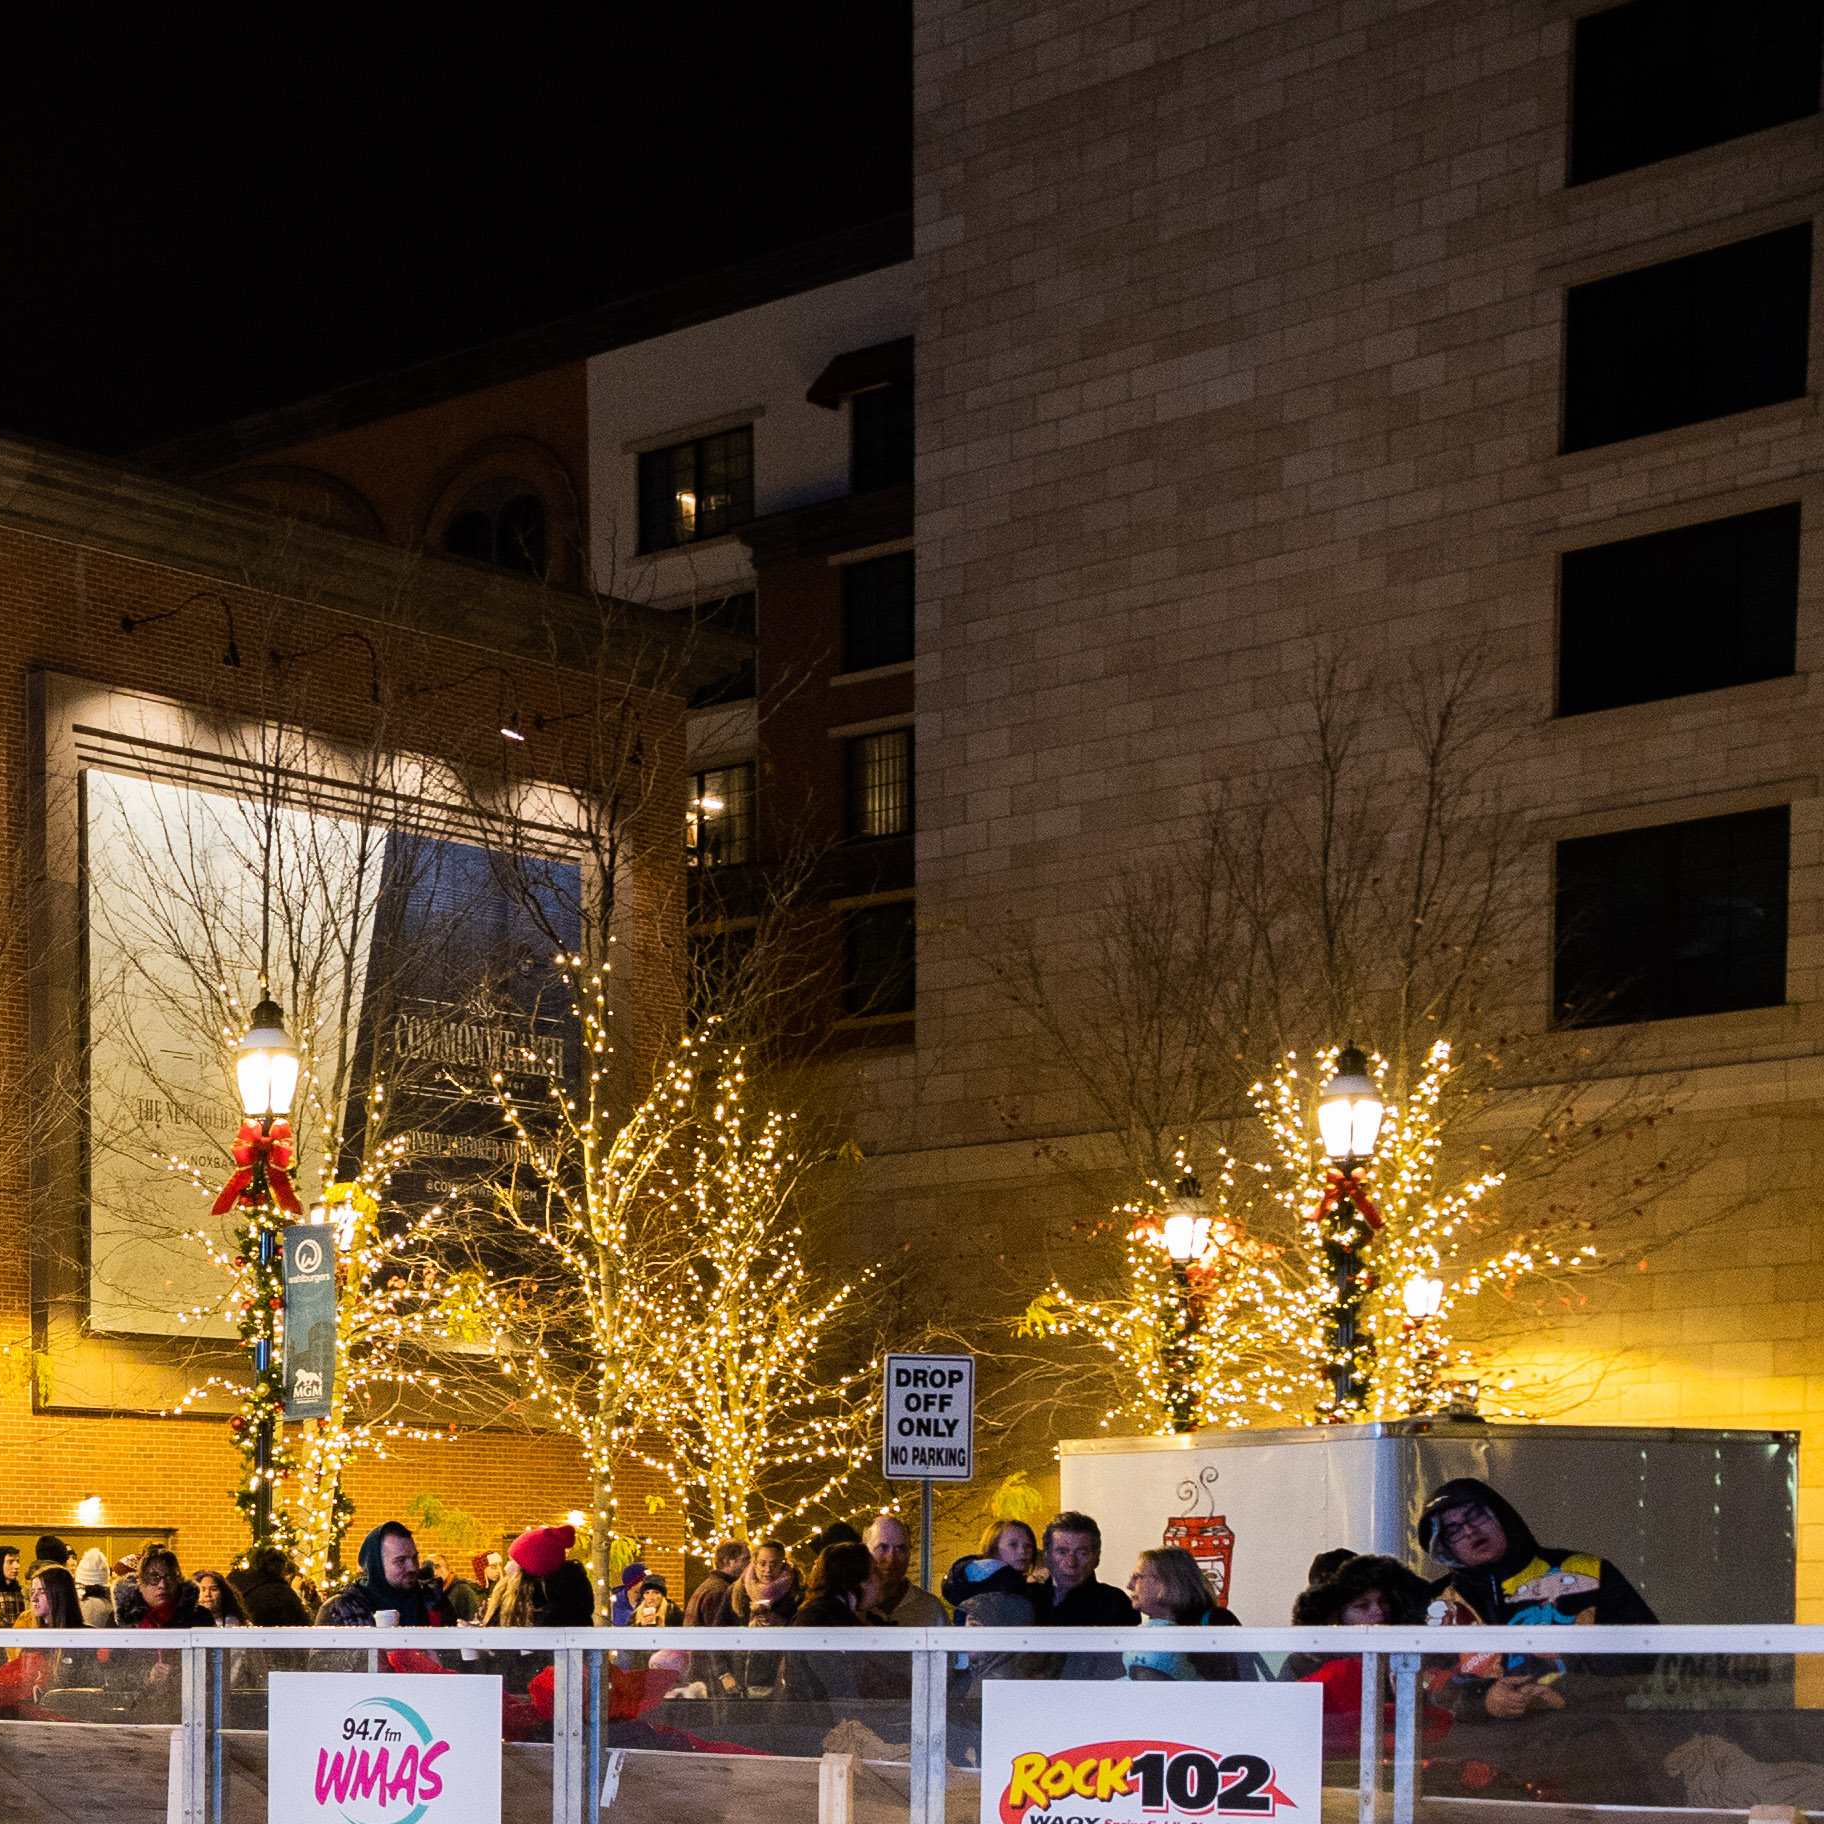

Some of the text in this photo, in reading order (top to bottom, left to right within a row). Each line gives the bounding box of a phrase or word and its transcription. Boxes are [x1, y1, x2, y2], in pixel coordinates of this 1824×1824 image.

[895, 1368, 964, 1388] DROP
[293, 1385, 323, 1398] MGM
[904, 1393, 953, 1412] OFF
[897, 1417, 960, 1438] ONLY
[890, 1446, 966, 1467] NO PARKING
[315, 1740, 451, 1808] WMAS
[1129, 1751, 1274, 1813] 102
